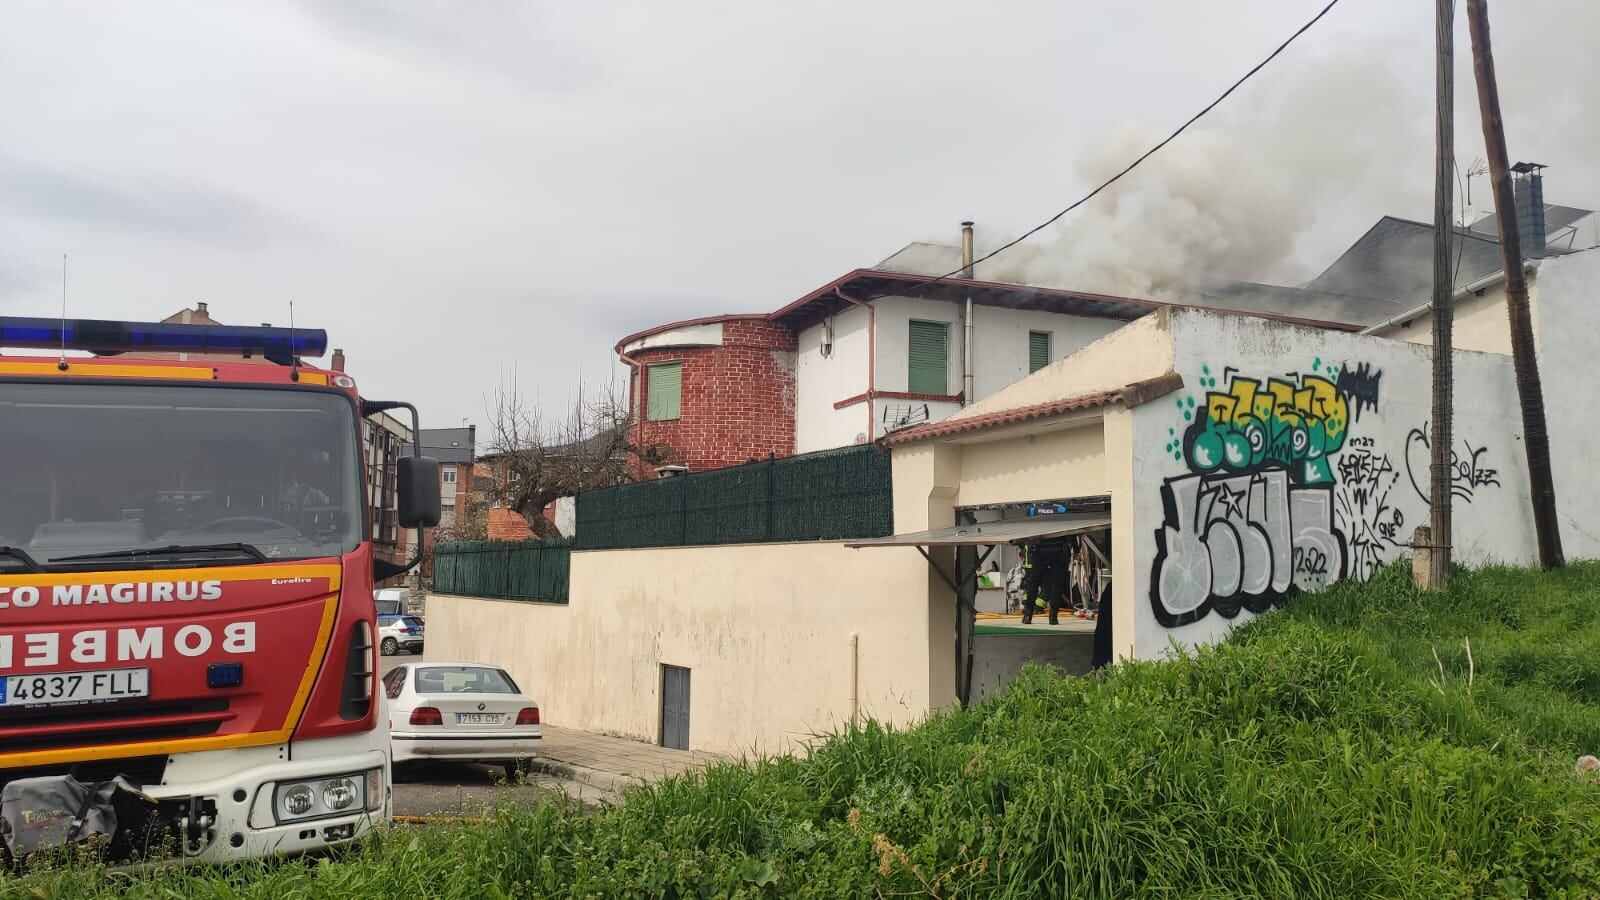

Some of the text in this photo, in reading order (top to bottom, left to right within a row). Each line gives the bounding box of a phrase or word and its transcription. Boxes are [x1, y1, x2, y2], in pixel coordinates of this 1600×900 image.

[1294, 547, 1327, 575] 2022
[52, 580, 222, 606] MAGIRUS
[271, 577, 312, 585] Eurofire
[13, 673, 142, 699] 4837 FLL
[462, 714, 481, 722] 7153
